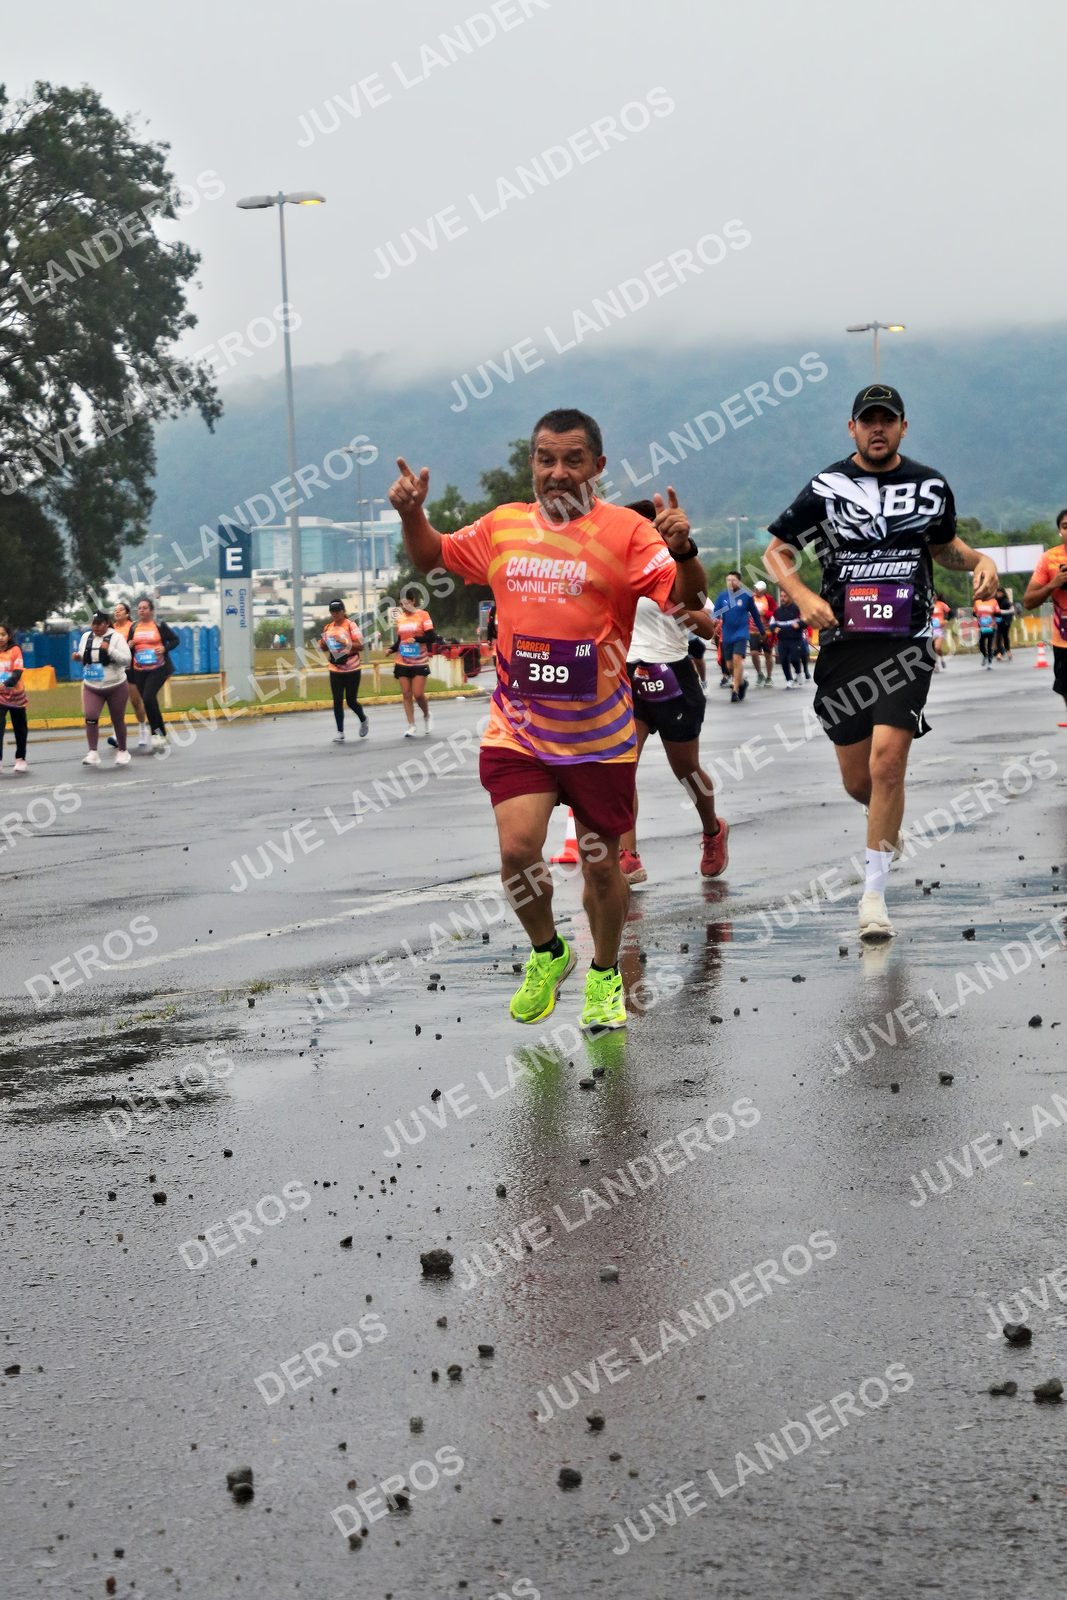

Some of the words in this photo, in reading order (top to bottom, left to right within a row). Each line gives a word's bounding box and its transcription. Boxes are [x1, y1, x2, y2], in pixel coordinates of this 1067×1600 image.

[226, 548, 243, 571] E
[506, 556, 587, 580] CARRERA
[838, 561, 919, 580] runner
[507, 579, 565, 594] OMNILIFE
[239, 589, 247, 628] General
[863, 604, 893, 619] 128
[515, 649, 541, 659] OMNILIFE
[516, 640, 551, 652] CARRERA
[575, 644, 591, 657] 15K
[528, 663, 569, 684] 389
[641, 679, 664, 692] 189
